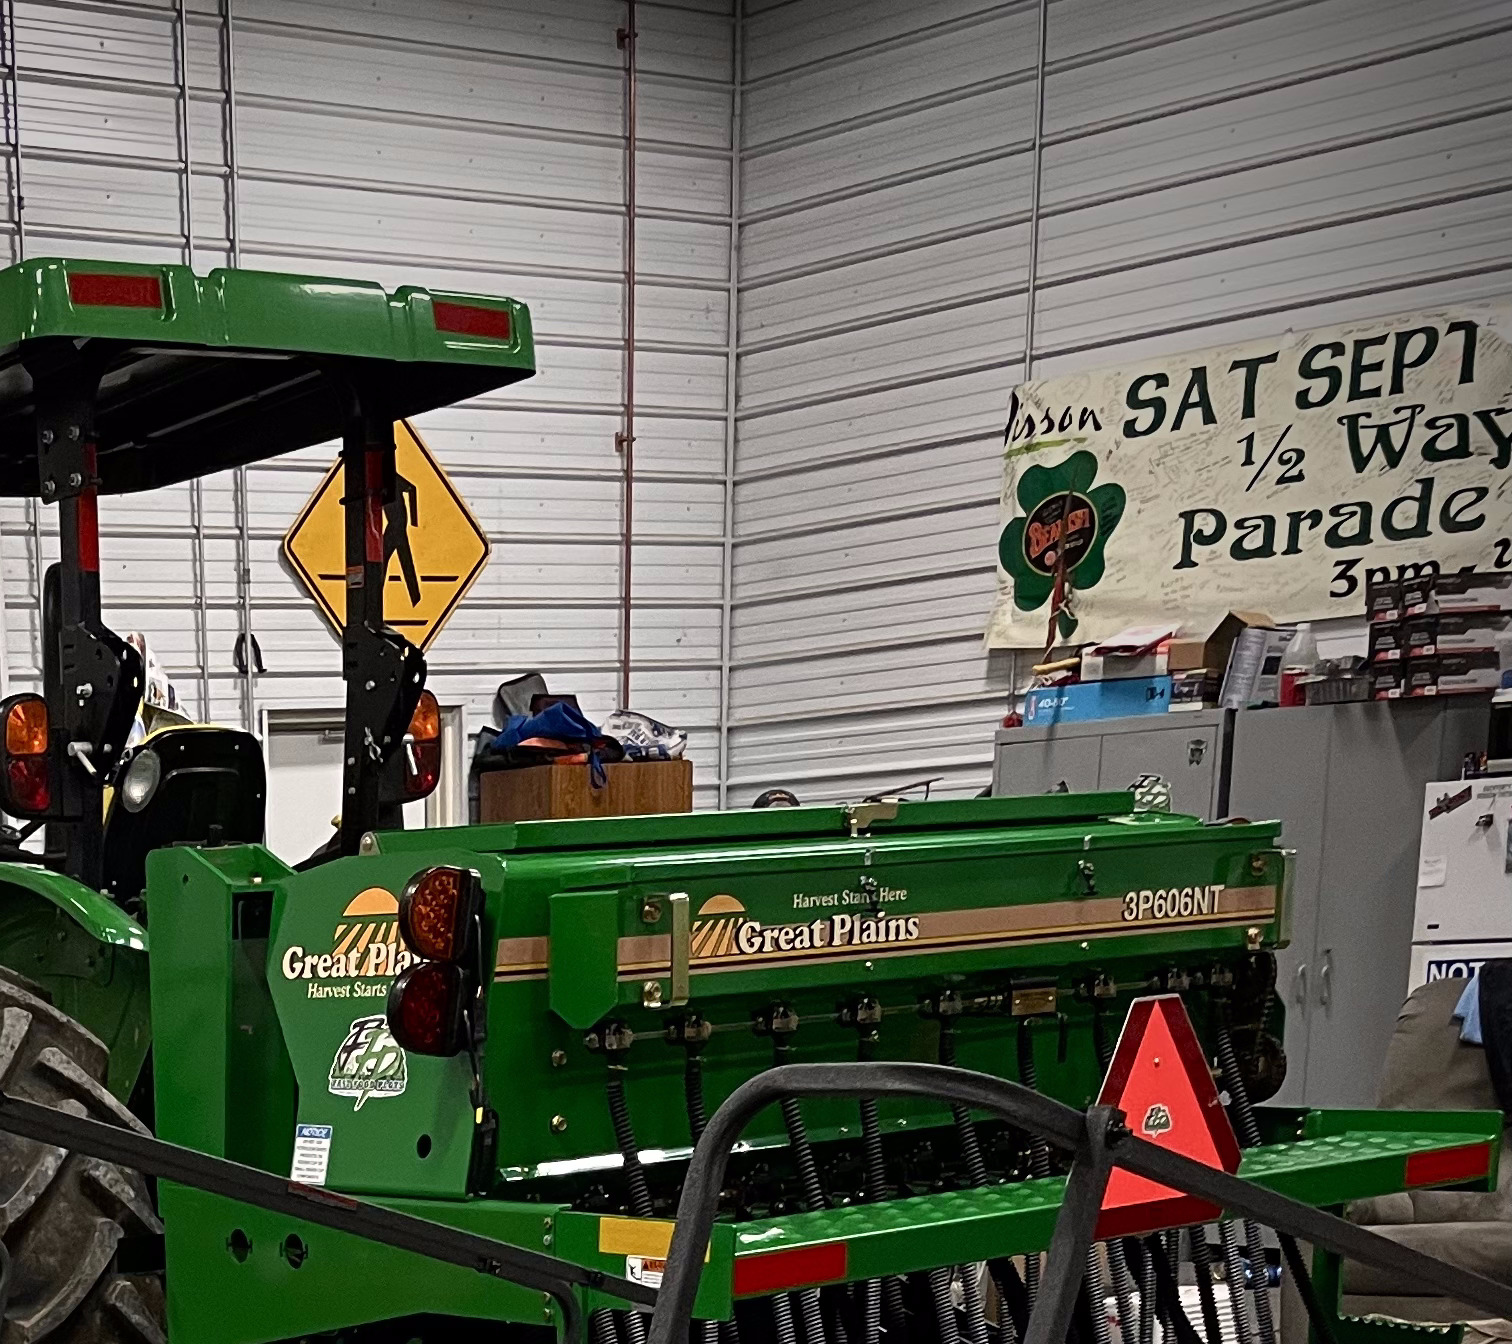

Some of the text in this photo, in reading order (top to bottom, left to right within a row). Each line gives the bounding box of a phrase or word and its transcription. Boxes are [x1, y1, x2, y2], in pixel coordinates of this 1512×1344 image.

[1123, 350, 1280, 439] SAT
[1172, 476, 1489, 570] Parade
[793, 893, 839, 909] Harvest
[879, 887, 908, 902] Here
[1123, 885, 1225, 921] 3P606NT
[738, 911, 919, 954] Great Plains
[282, 946, 361, 980] Great
[307, 981, 387, 998] Harvest Starts
